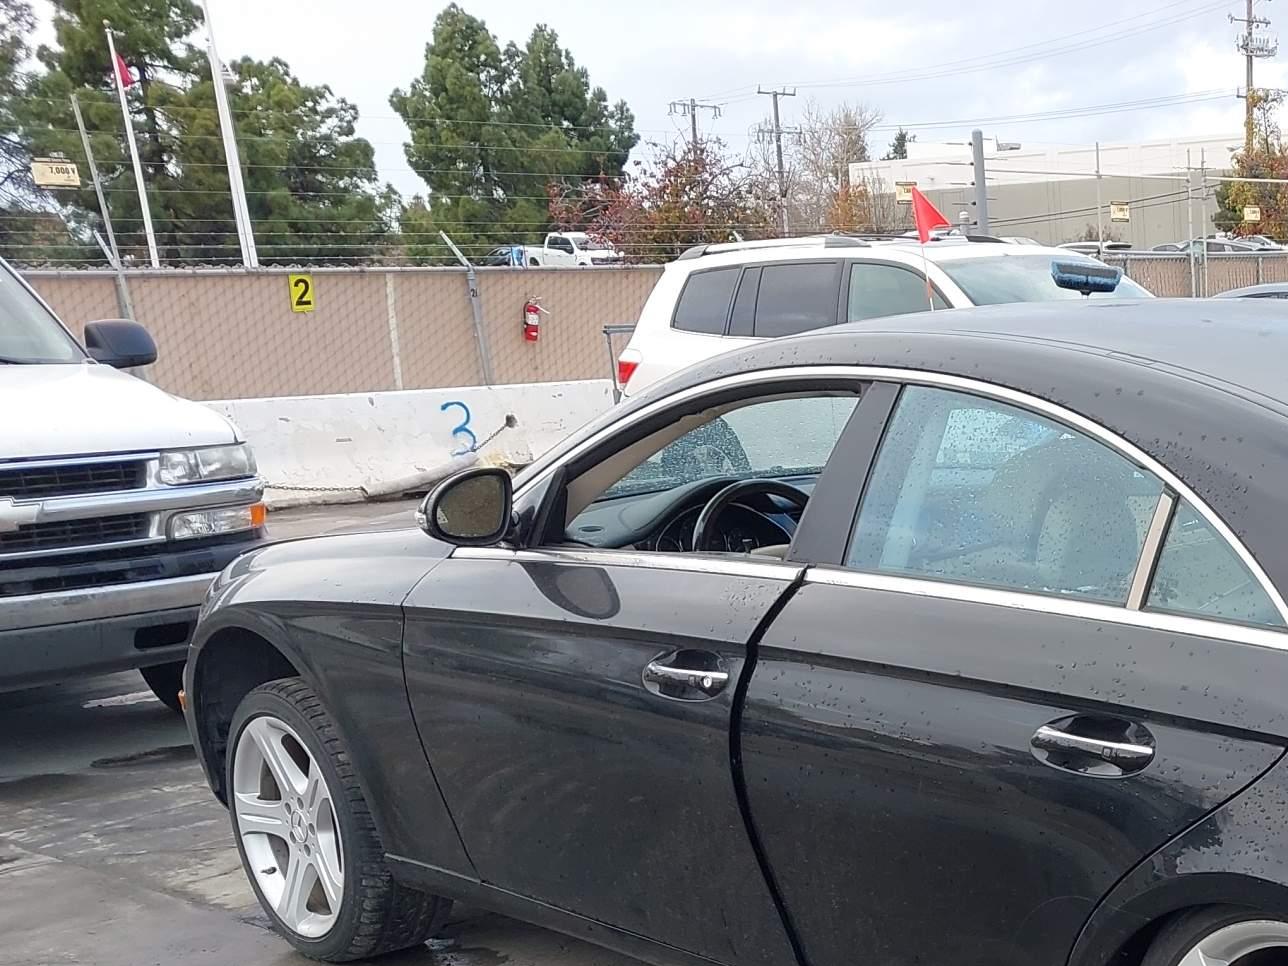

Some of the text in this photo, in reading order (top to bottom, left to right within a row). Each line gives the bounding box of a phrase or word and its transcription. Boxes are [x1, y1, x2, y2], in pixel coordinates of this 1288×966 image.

[48, 166, 70, 175] 7,000
[293, 278, 312, 306] 2
[440, 401, 477, 457] 3
